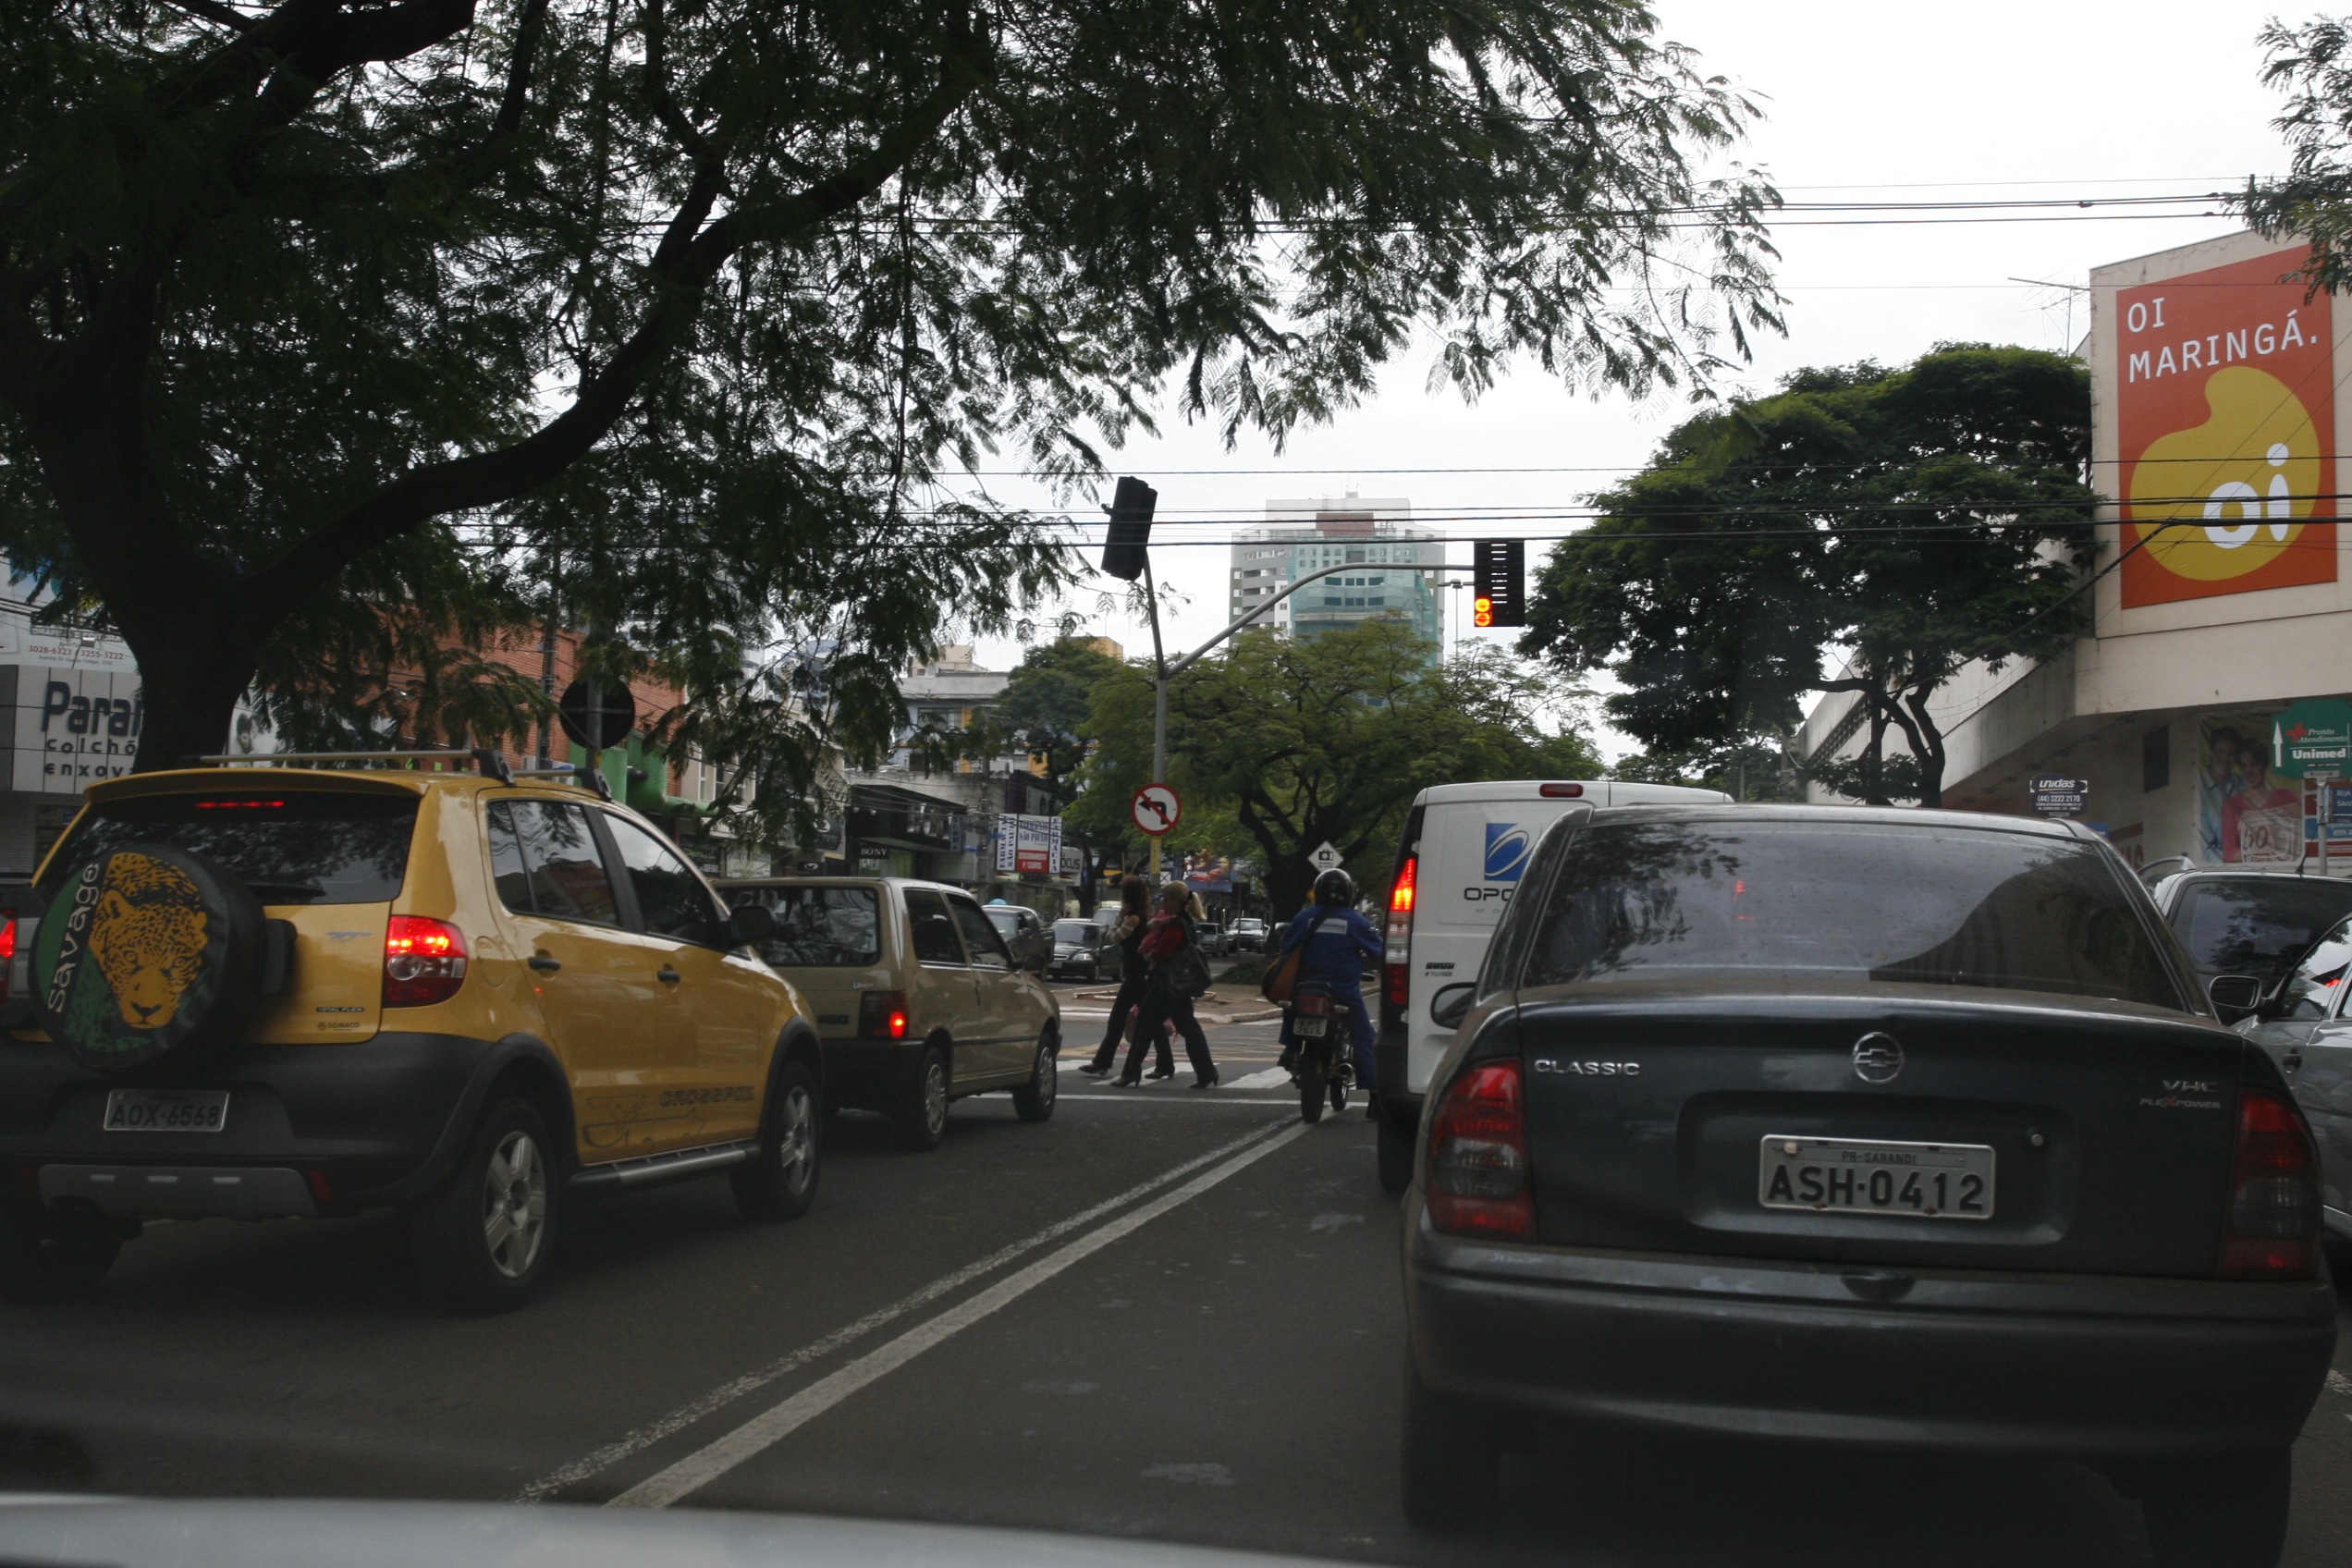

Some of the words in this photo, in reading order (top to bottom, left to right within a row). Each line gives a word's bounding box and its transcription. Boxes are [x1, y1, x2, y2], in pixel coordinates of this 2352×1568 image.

[2127, 297, 2165, 333] OI
[2129, 309, 2317, 383] MARINGÁ.
[2203, 443, 2291, 549] oi
[29, 645, 72, 655] 3028-6323
[80, 649, 123, 660] 3255-3222
[2297, 735, 2348, 743] Atendimento
[2292, 748, 2347, 759] Unimed
[44, 763, 134, 778] enxov
[2039, 778, 2076, 789] unidas
[47, 863, 100, 1013] Savage
[1535, 1059, 1640, 1076] CLASSIC
[1841, 1150, 1917, 1165] PR-SARANDI
